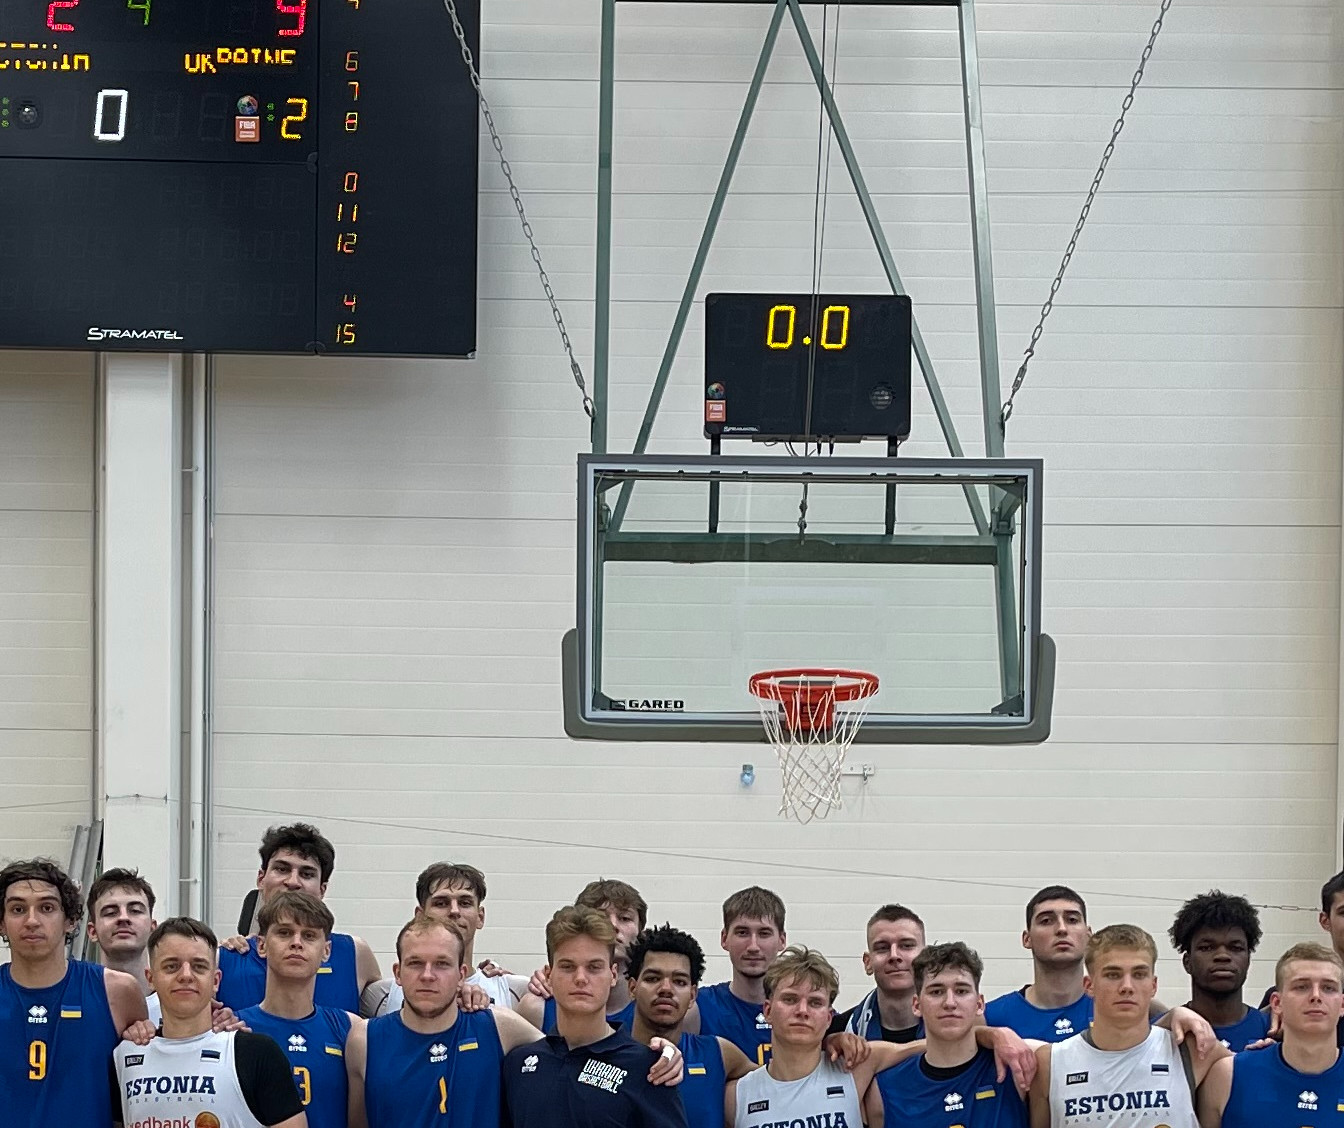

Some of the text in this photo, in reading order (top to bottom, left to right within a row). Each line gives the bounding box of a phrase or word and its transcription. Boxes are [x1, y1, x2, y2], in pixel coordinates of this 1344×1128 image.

[348, 81, 359, 101] 7
[93, 89, 128, 141] 0
[280, 97, 308, 140] 2
[337, 233, 358, 253] 12
[87, 327, 184, 340] STRAMATEL
[336, 323, 356, 344] 15
[628, 699, 684, 709] GARED
[28, 1040, 47, 1080] 9
[1064, 1090, 1170, 1117] ESTONIA
